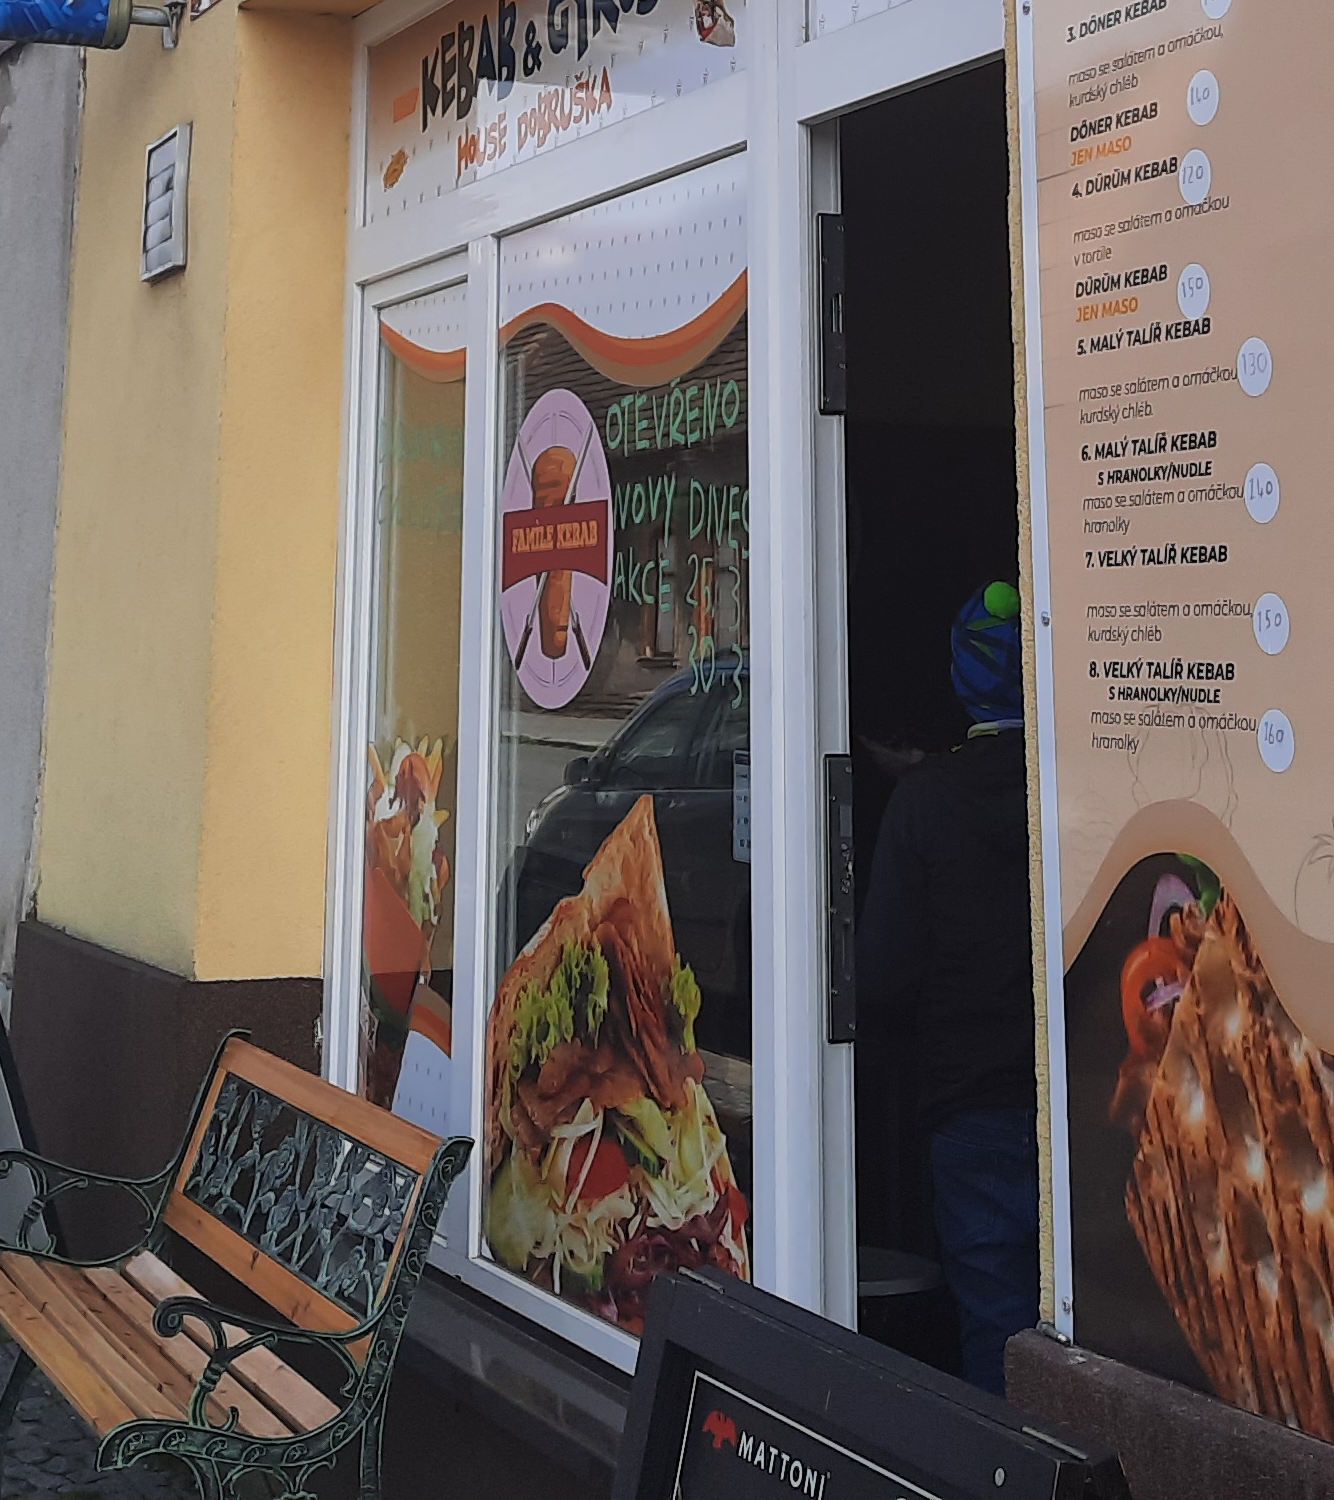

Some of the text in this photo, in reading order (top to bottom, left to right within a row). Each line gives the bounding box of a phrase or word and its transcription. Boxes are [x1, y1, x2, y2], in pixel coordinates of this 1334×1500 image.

[1079, 10, 1121, 38] DÖNER
[523, 20, 542, 77] &
[1069, 68, 1096, 85] maso
[457, 66, 613, 179] HOUSE DOBRUŠKA
[1071, 102, 1158, 142] DÖNER KEBAB
[1071, 136, 1131, 166] JEN MASO
[1086, 157, 1177, 196] DÜRÜM KEBAB
[1074, 212, 1162, 244] maso salátem
[1075, 264, 1167, 298] DÜRÜM KEBAB
[1076, 297, 1138, 322] JEN MASO
[1077, 317, 1211, 355] 5. MALÝ TALÍŘ KEBAB
[1079, 376, 1169, 402] maso salátem
[1080, 406, 1119, 424] kurdský
[1082, 431, 1217, 461] 6. MALÝ TALÍŘ KEBAB
[1107, 461, 1212, 484] HRANOLKY/NUDLE
[1083, 488, 1174, 511] maso salátem
[557, 520, 597, 549] KEBAB
[1084, 516, 1130, 534] hranolky
[1086, 544, 1227, 568] 7. VELKÝ TALÍŘ KEBAB
[614, 547, 670, 612] AKCE
[1087, 604, 1117, 618] maso
[1134, 601, 1179, 617] salátem
[1088, 626, 1162, 646] kurdský chléb
[1090, 658, 1235, 680] 8. VELKÝ TALÍŘ KEBAB
[1118, 686, 1221, 704] HRANOLKY/NUDLE
[1091, 711, 1121, 724] maso
[1138, 710, 1185, 728] salátem
[1092, 733, 1139, 754] hranolky
[738, 1431, 826, 1500] MATTONI
